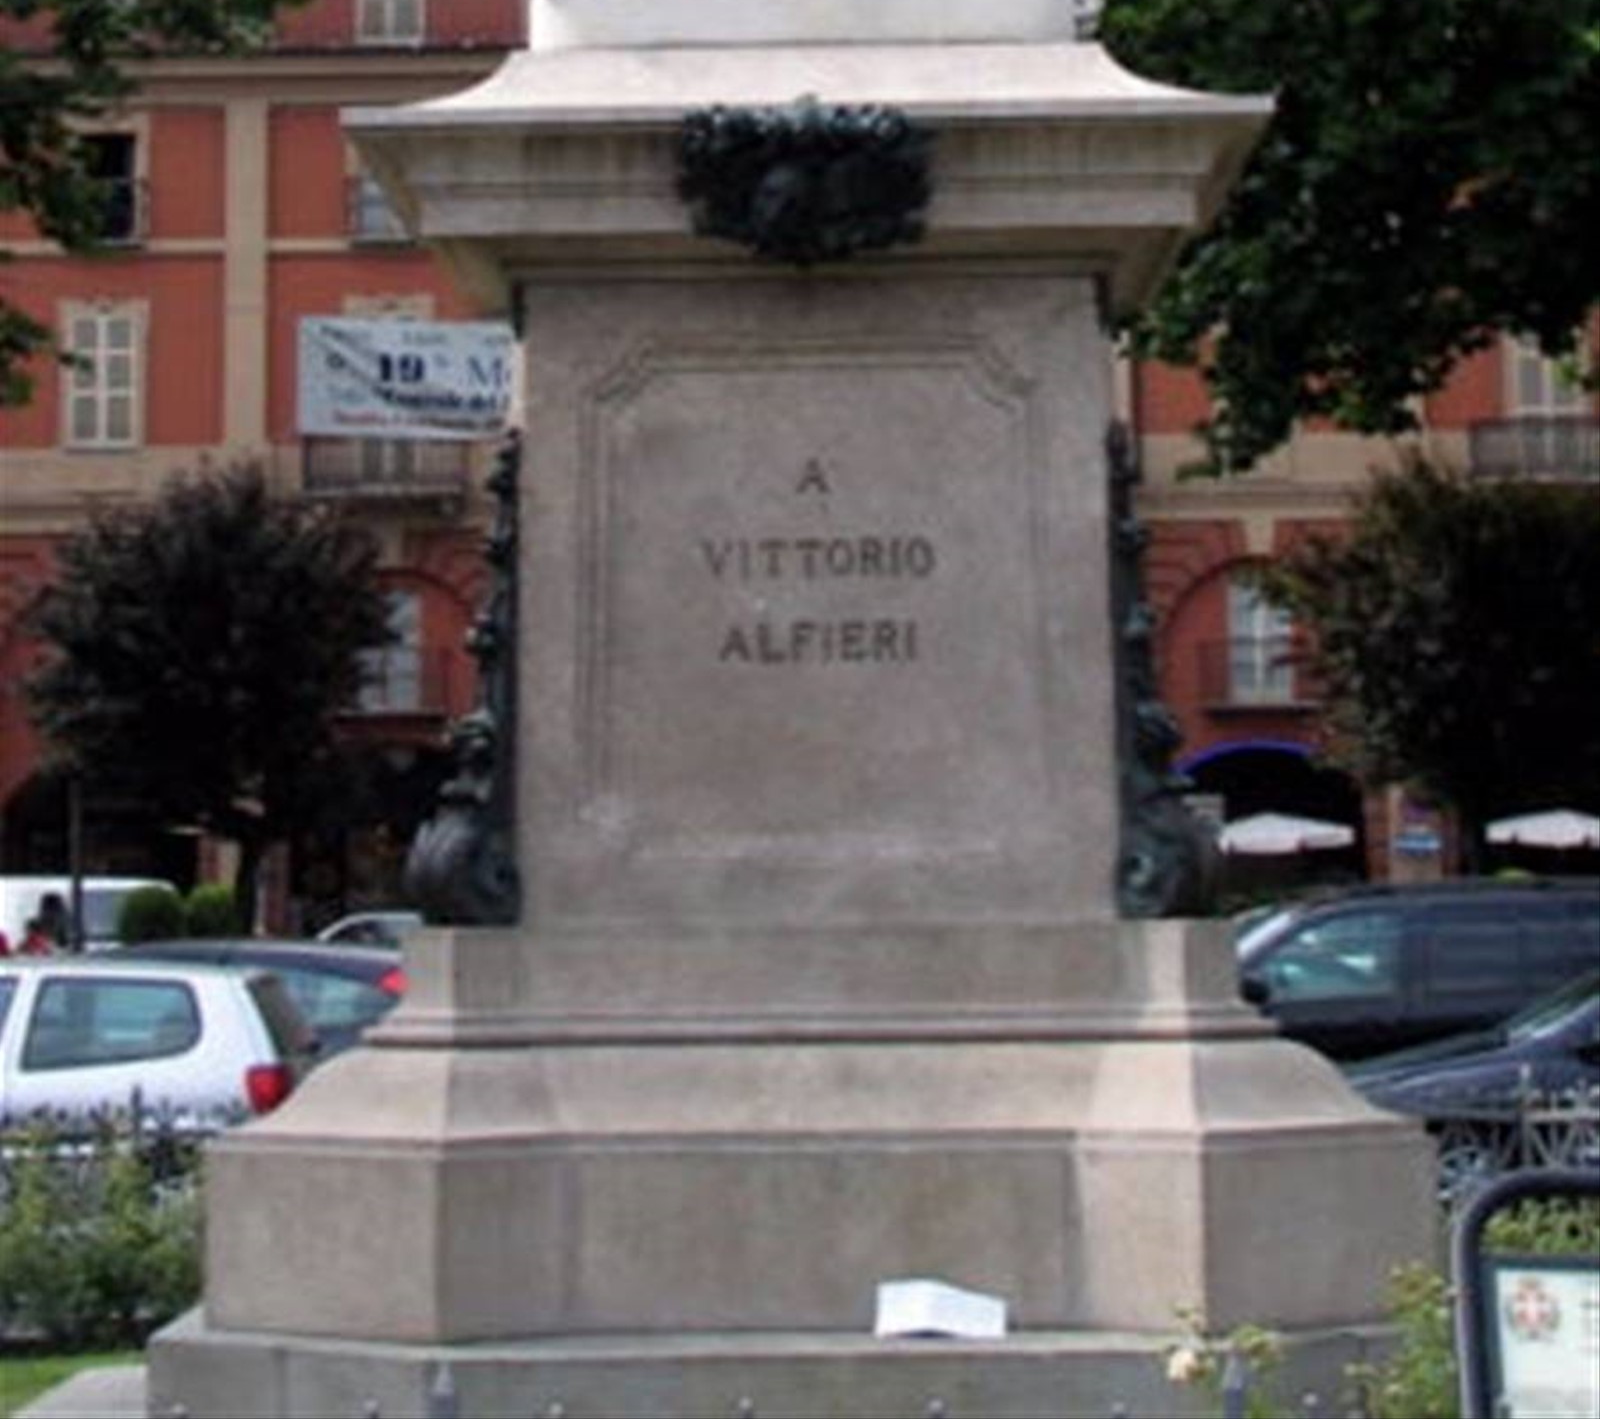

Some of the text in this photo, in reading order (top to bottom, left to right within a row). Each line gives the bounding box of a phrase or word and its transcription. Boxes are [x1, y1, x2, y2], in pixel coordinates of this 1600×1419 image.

[796, 456, 830, 494] A
[701, 535, 936, 579] VITTORIO
[719, 618, 918, 663] ALFIERI
